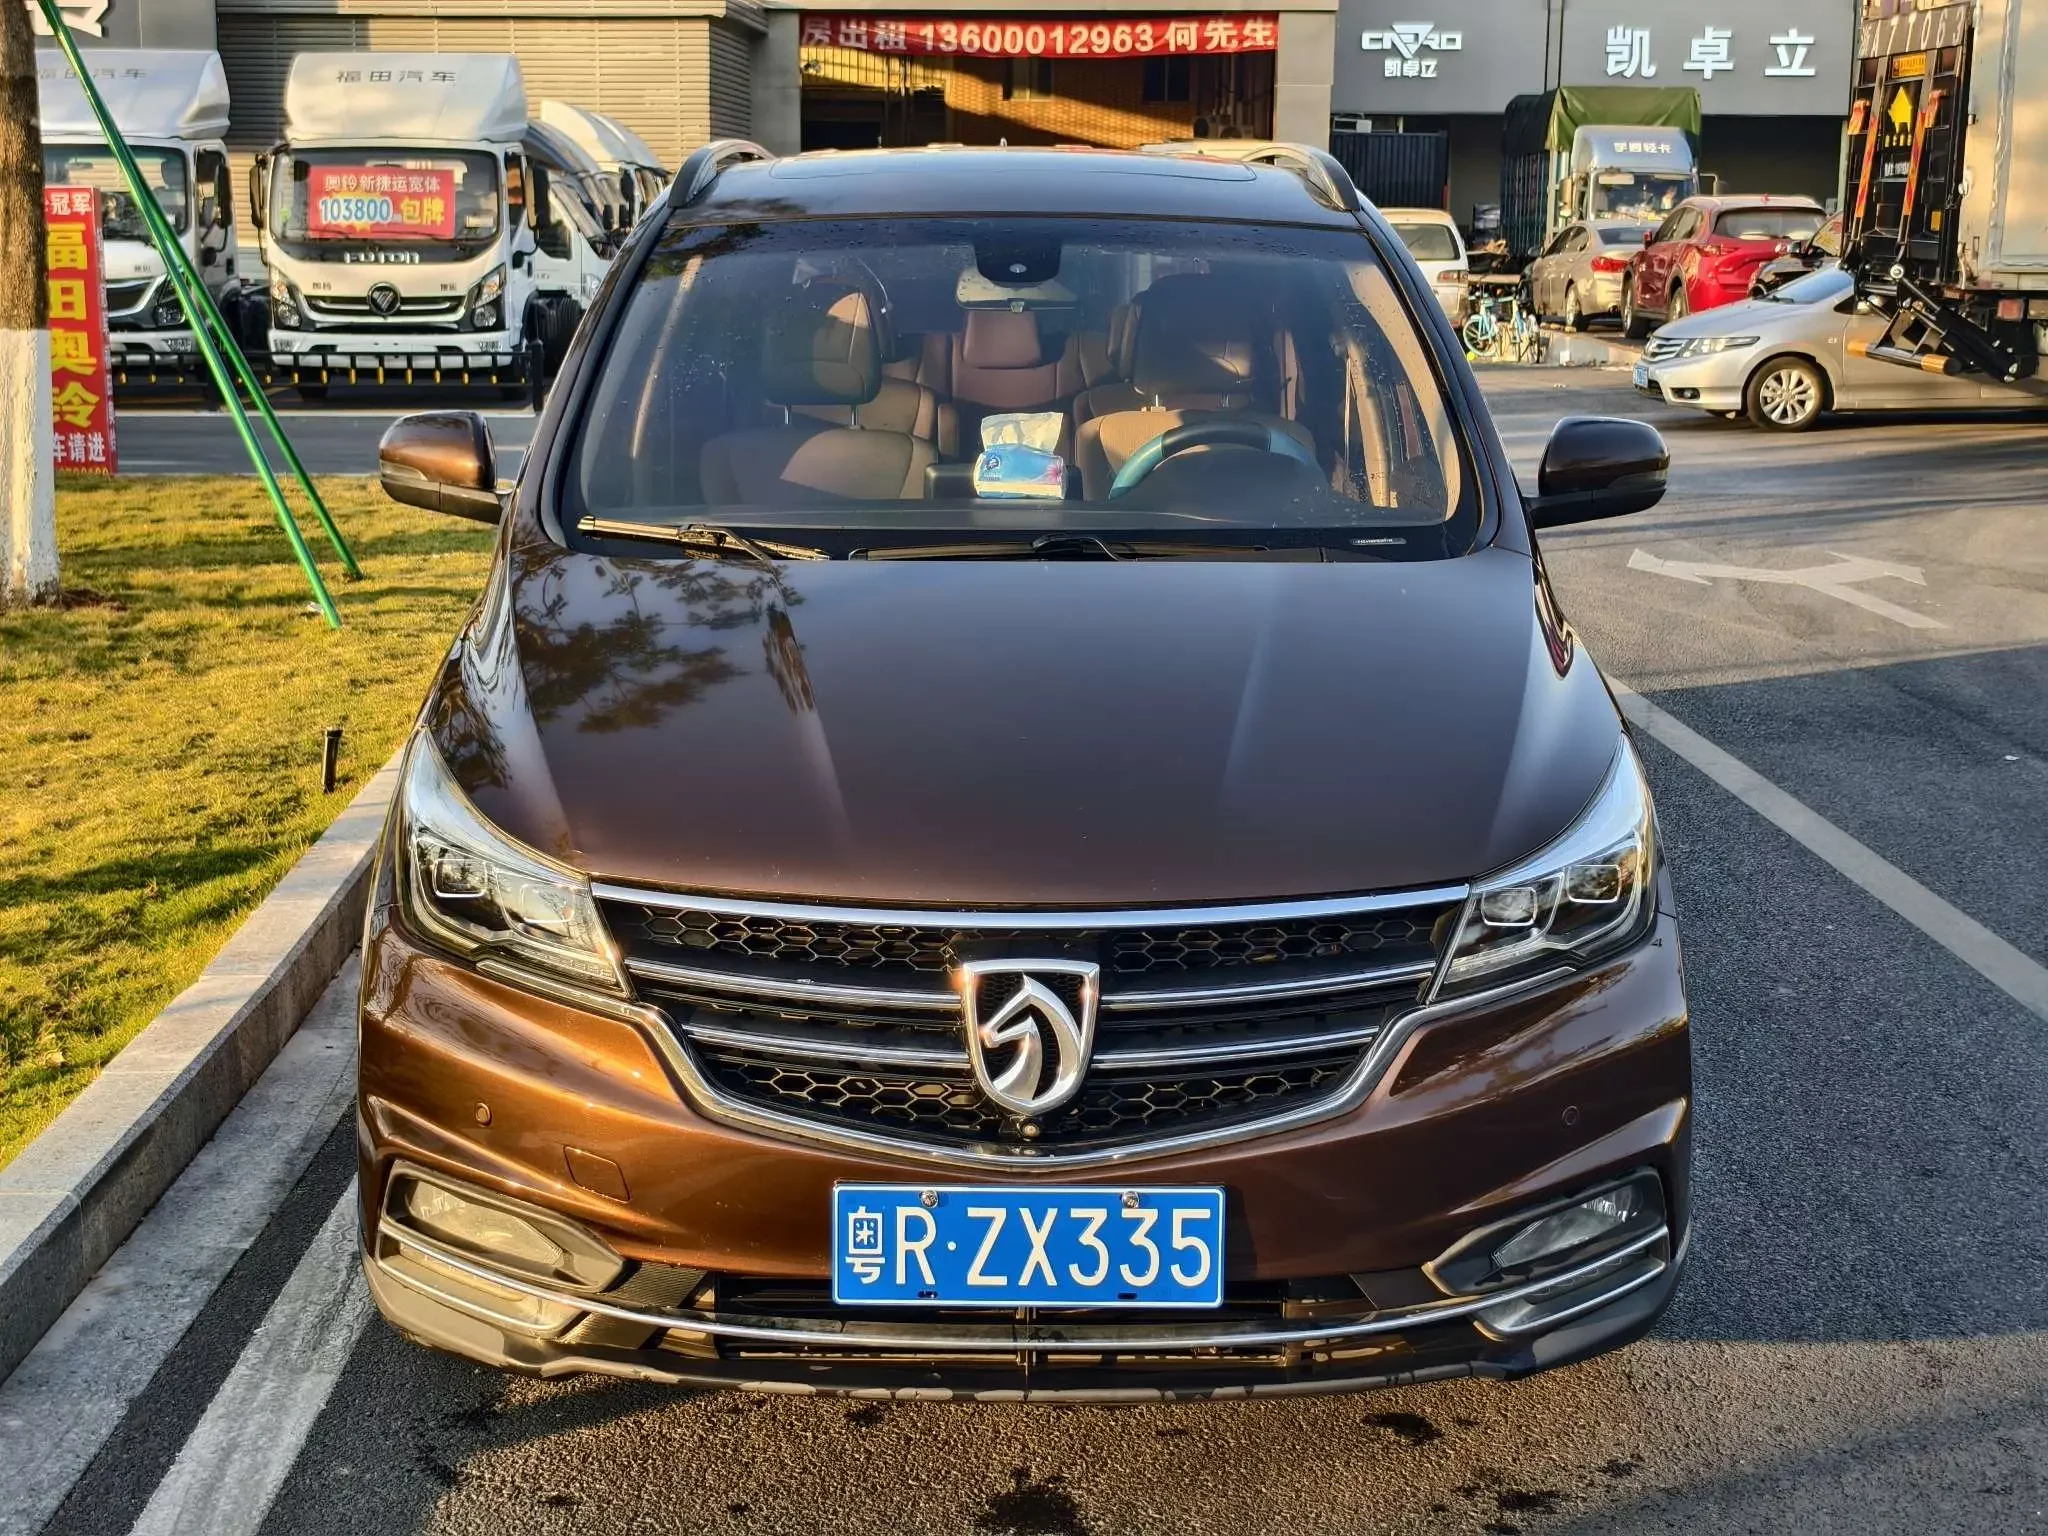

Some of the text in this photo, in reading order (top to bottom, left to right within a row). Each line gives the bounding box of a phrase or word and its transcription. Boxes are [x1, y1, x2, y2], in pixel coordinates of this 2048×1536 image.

[802, 17, 1274, 54] 房出租 13600012963 何先生
[1605, 25, 1817, 80] 凯卓立
[336, 70, 457, 83] 福田汽车
[1384, 59, 1438, 78] 凯卓立
[324, 174, 441, 193] 奥铃新捷运宽体
[44, 192, 92, 216] 冠军
[319, 196, 446, 226] 103800 包牌
[845, 1205, 1212, 1287] 粤R·ZX335
